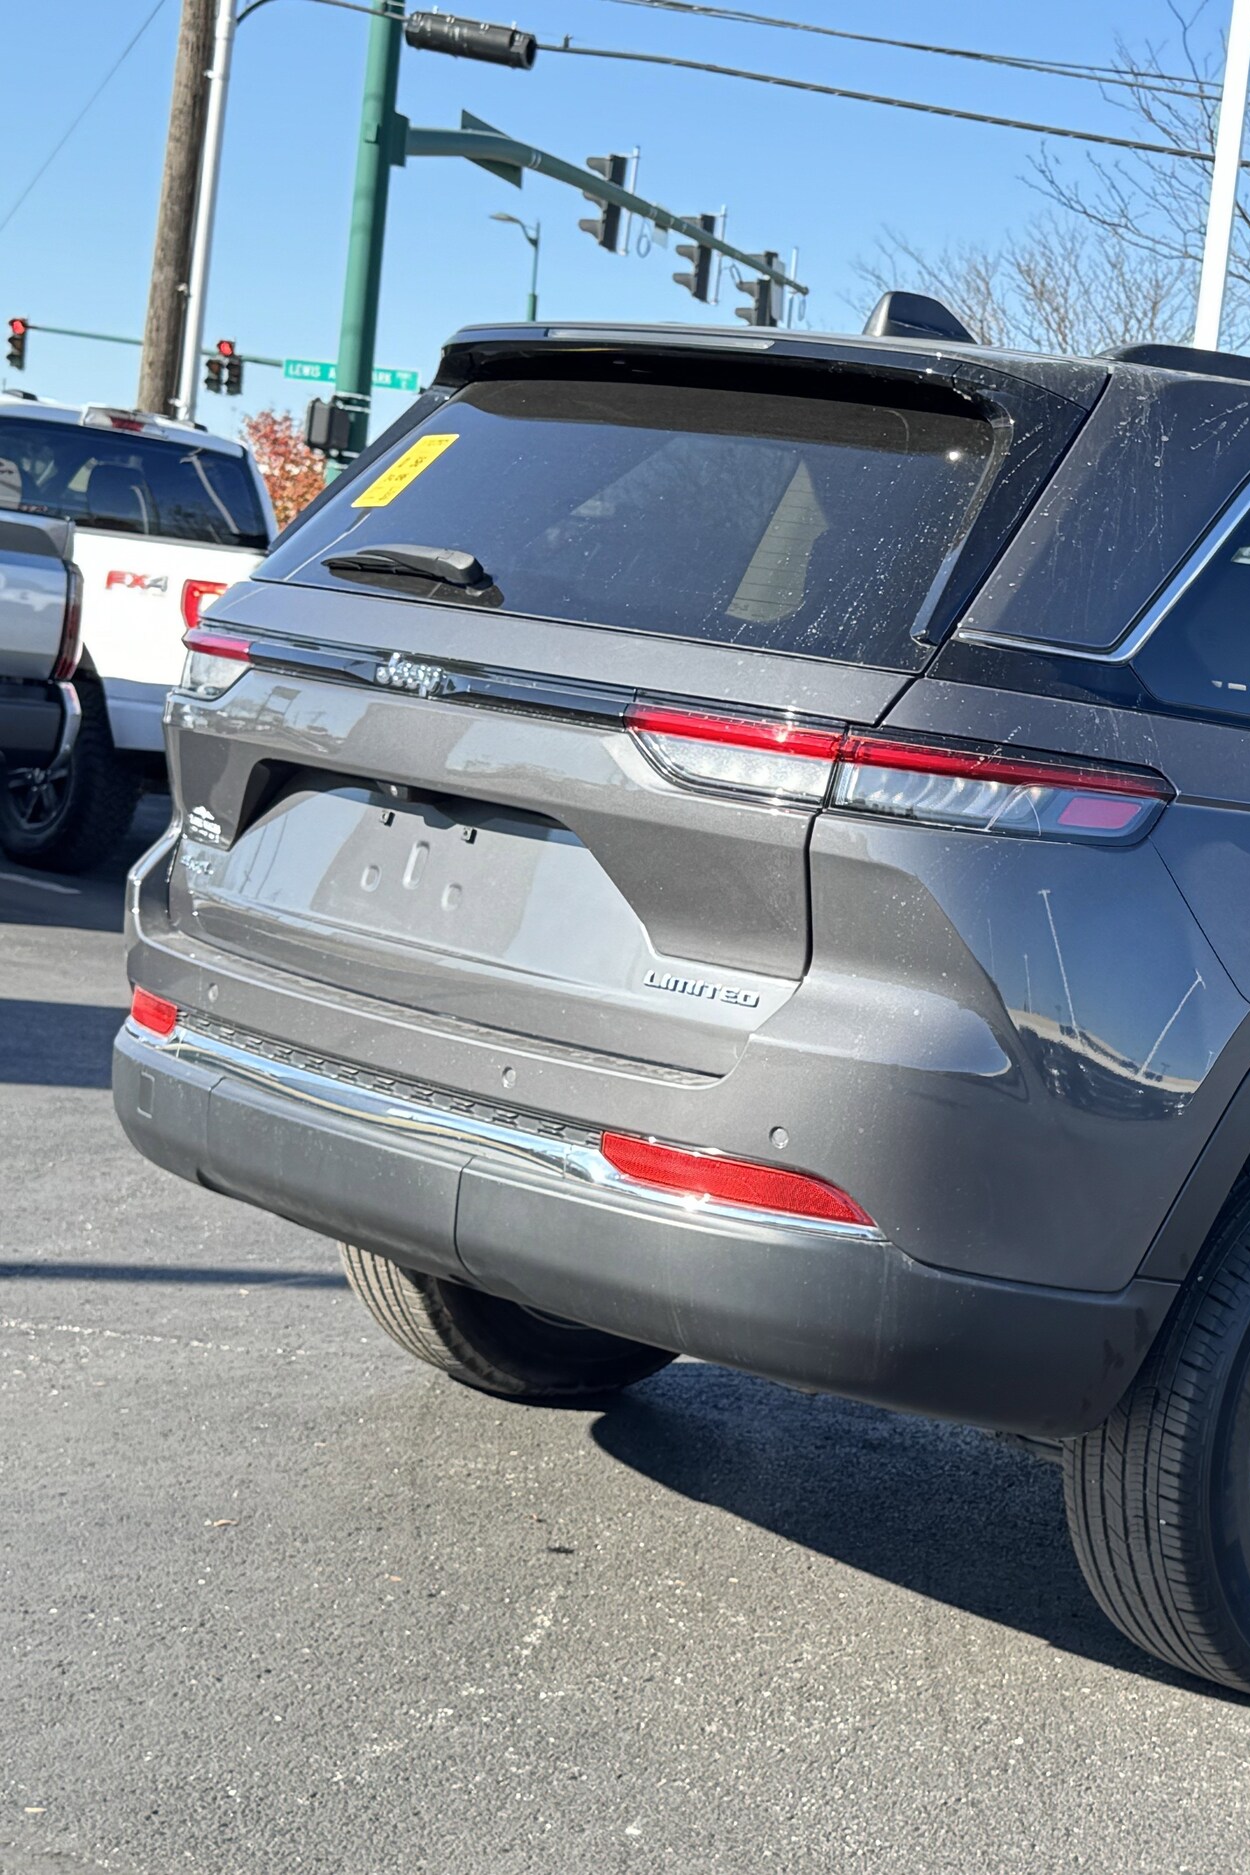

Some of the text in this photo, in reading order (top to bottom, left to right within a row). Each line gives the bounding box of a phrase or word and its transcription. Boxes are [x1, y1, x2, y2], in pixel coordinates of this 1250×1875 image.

[288, 363, 322, 378] LEWIS
[105, 570, 169, 593] FX4
[643, 969, 760, 1008] LIMITED
